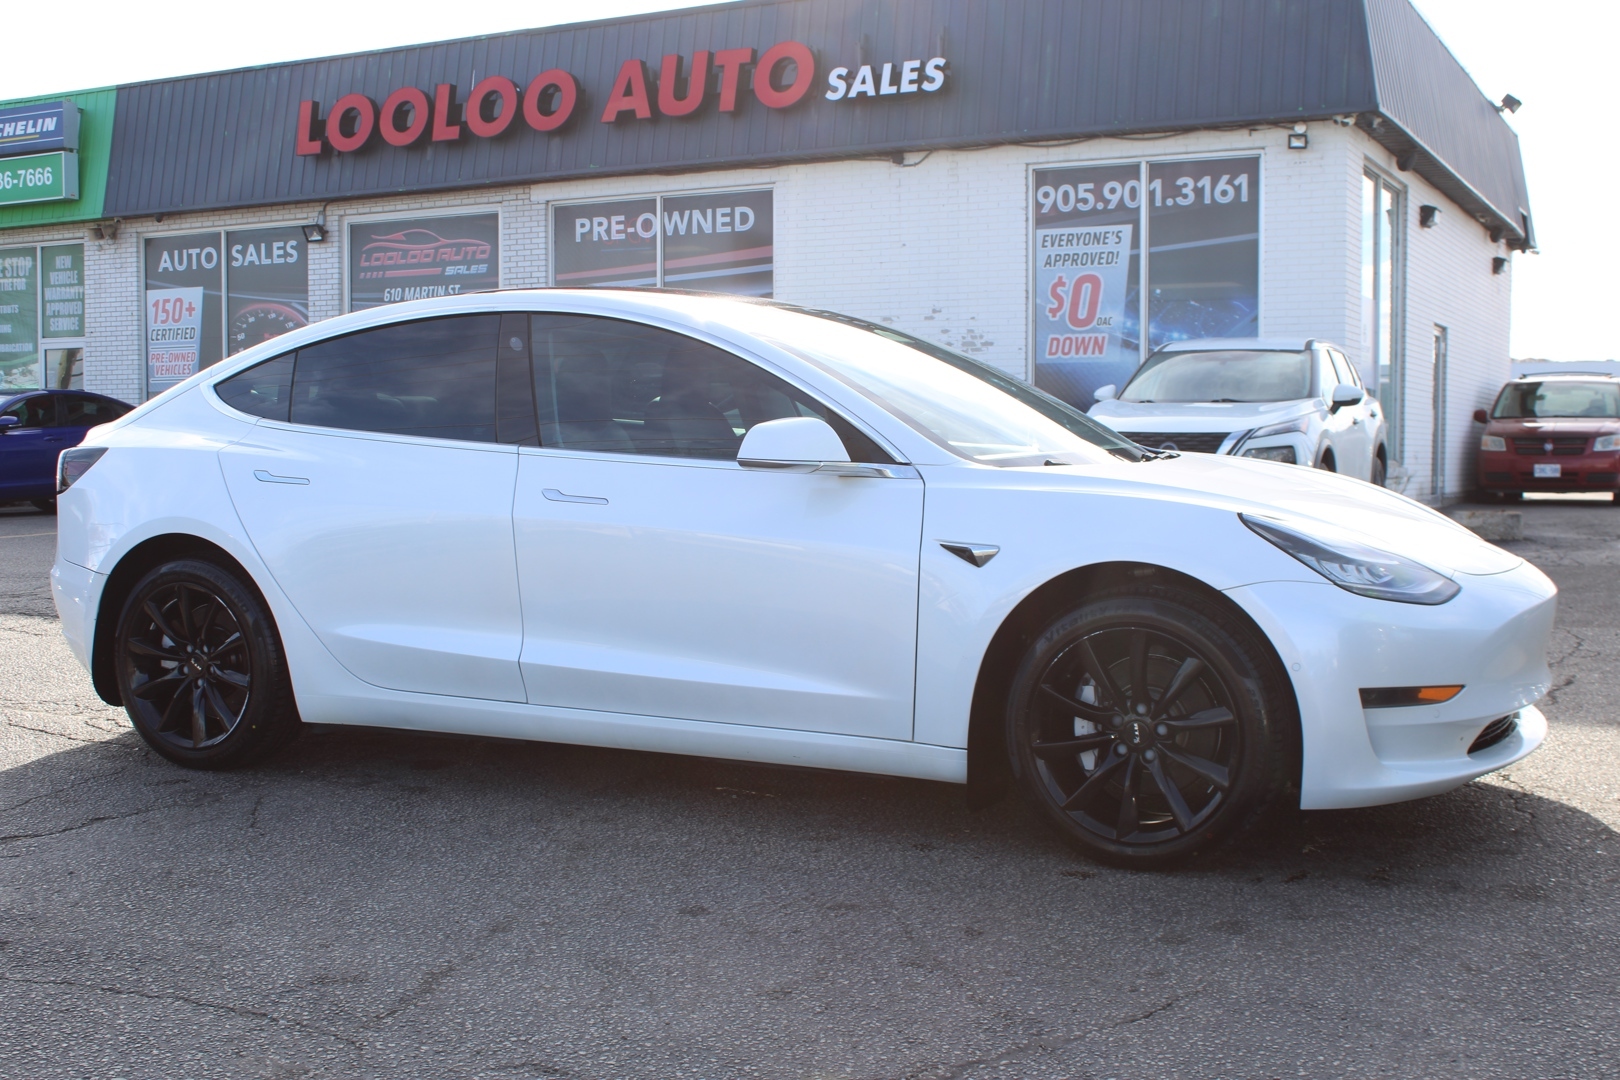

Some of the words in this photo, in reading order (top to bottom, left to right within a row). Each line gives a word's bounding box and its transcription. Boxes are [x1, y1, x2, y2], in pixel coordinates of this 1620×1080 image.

[296, 68, 577, 156] LOOLOO
[601, 40, 815, 123] AUTO
[825, 57, 947, 101] SALES
[1037, 173, 1249, 213] 905.901.3161
[575, 206, 755, 242] PRE-OWNED
[1041, 230, 1123, 249] EVERYONE'S
[55, 255, 72, 269] NEW
[158, 246, 218, 272] AUTO
[231, 240, 299, 267] SALES
[360, 249, 435, 267] LOOLOO
[436, 245, 491, 262] AUTO
[1043, 251, 1120, 268] APPROVED!
[49, 271, 78, 285] VEHICLE
[444, 263, 489, 276] SALES
[44, 285, 84, 300] WARRANTY
[384, 287, 402, 302] 610
[404, 285, 446, 301] MARTIN
[1048, 273, 1102, 329] $0
[46, 301, 82, 316] APPROVED
[152, 297, 196, 324] 150+
[50, 317, 79, 331] SERVICE
[150, 327, 196, 341] CERTIFIED
[1047, 335, 1106, 357] DOWN
[150, 351, 196, 363] PRE-OWNED
[155, 364, 192, 376] VEHICLES
